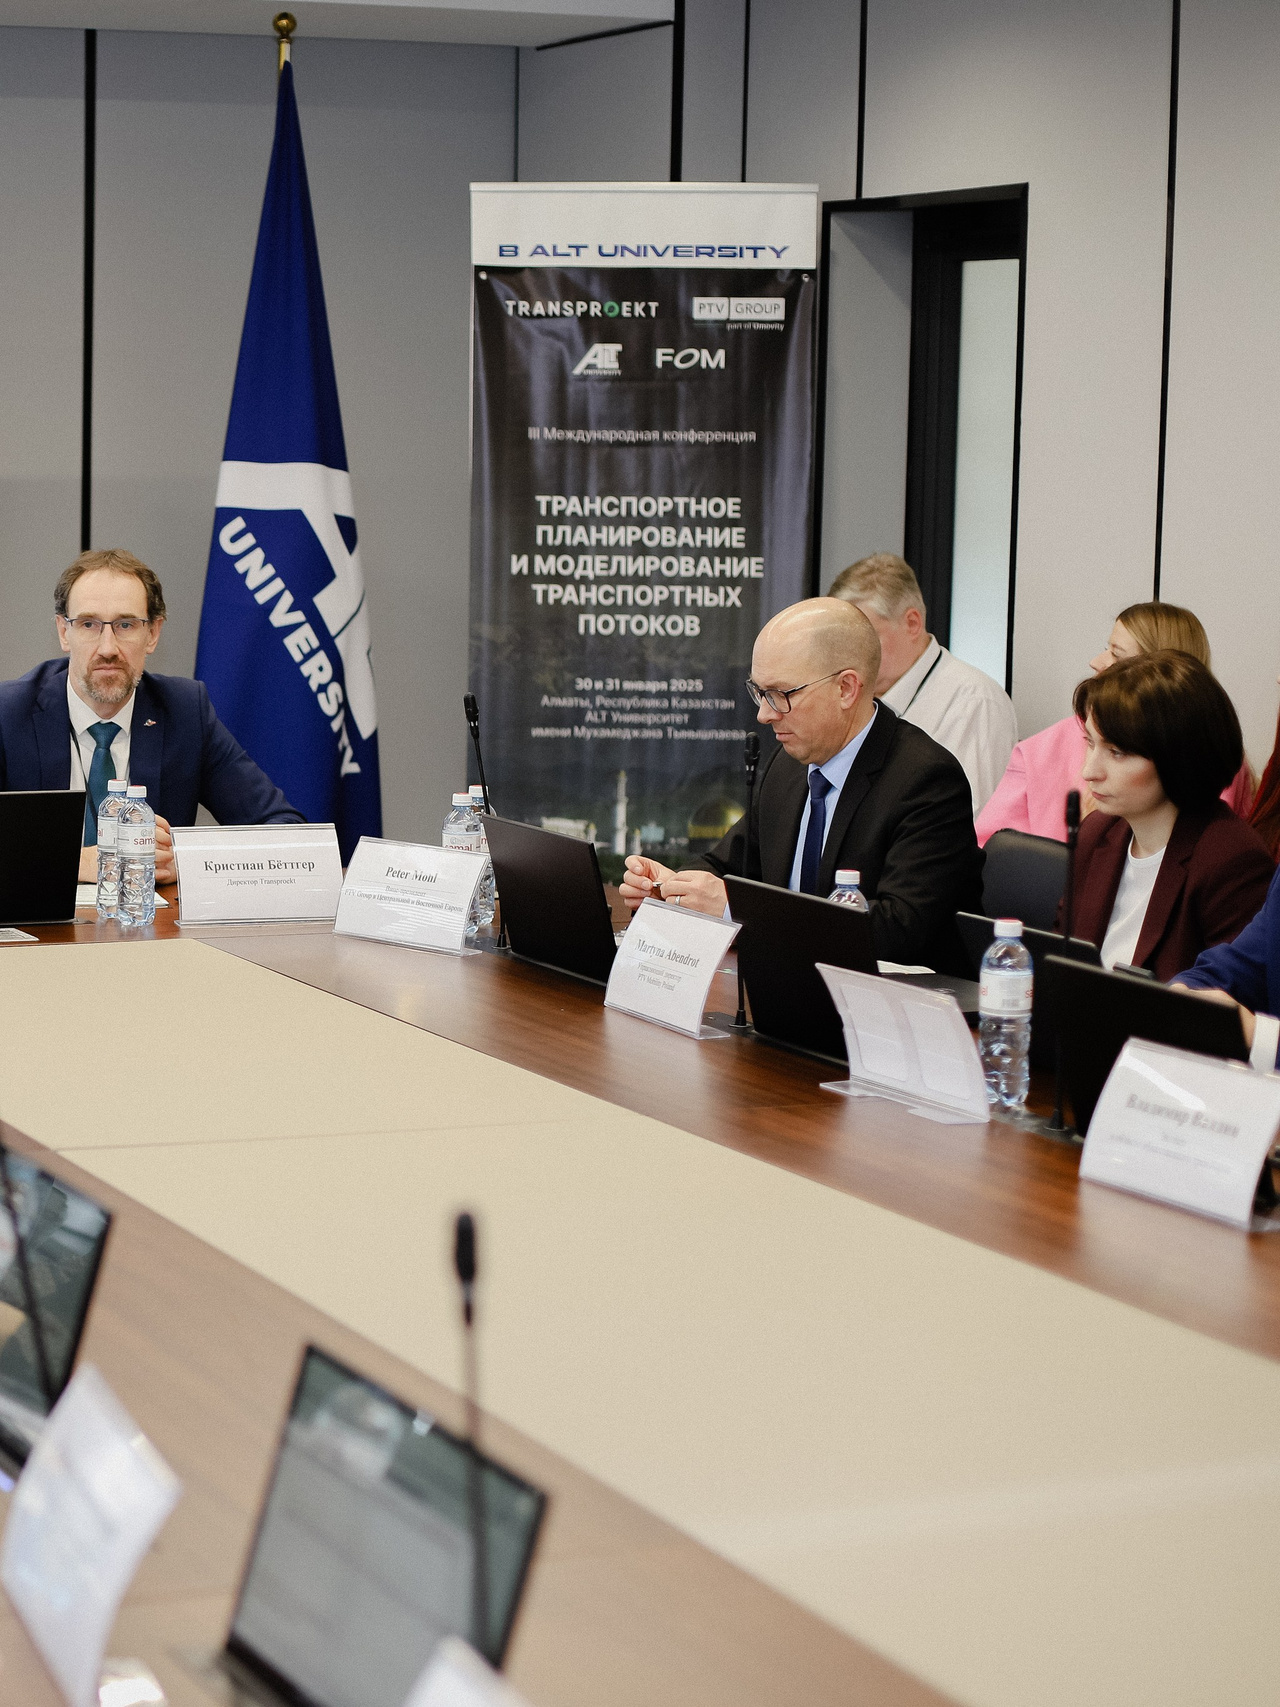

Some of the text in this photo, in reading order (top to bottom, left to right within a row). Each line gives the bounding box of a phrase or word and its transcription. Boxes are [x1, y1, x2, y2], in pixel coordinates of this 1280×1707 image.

[529, 244, 588, 257] ALT
[598, 244, 790, 259] UNIVERSITY
[505, 300, 659, 318] TRANSPROEKT
[698, 302, 781, 315] PTV GROUP
[655, 348, 726, 370] FOM
[544, 427, 659, 444] Международная
[663, 428, 756, 445] конференция
[535, 495, 742, 519] ТРАНСПОРТНОЕ
[536, 524, 746, 548] ПЛАНИРОВАНИЕ
[511, 554, 765, 580] И МОДЕЛИРОВАНИЕ
[531, 584, 743, 607] ТРАНСПОРТНЫХ
[578, 613, 701, 636] ПОТОКОВ
[574, 677, 703, 694] 30 и 31 января 2025
[541, 695, 735, 710] Алматы, Республика Казахстан
[611, 711, 689, 726] Университет
[531, 727, 572, 738] имени
[204, 860, 315, 873] Кристиан Бёттгер
[385, 866, 411, 880] Peter
[227, 879, 258, 887] Директор
[634, 939, 700, 968] Martyna Abendrot
